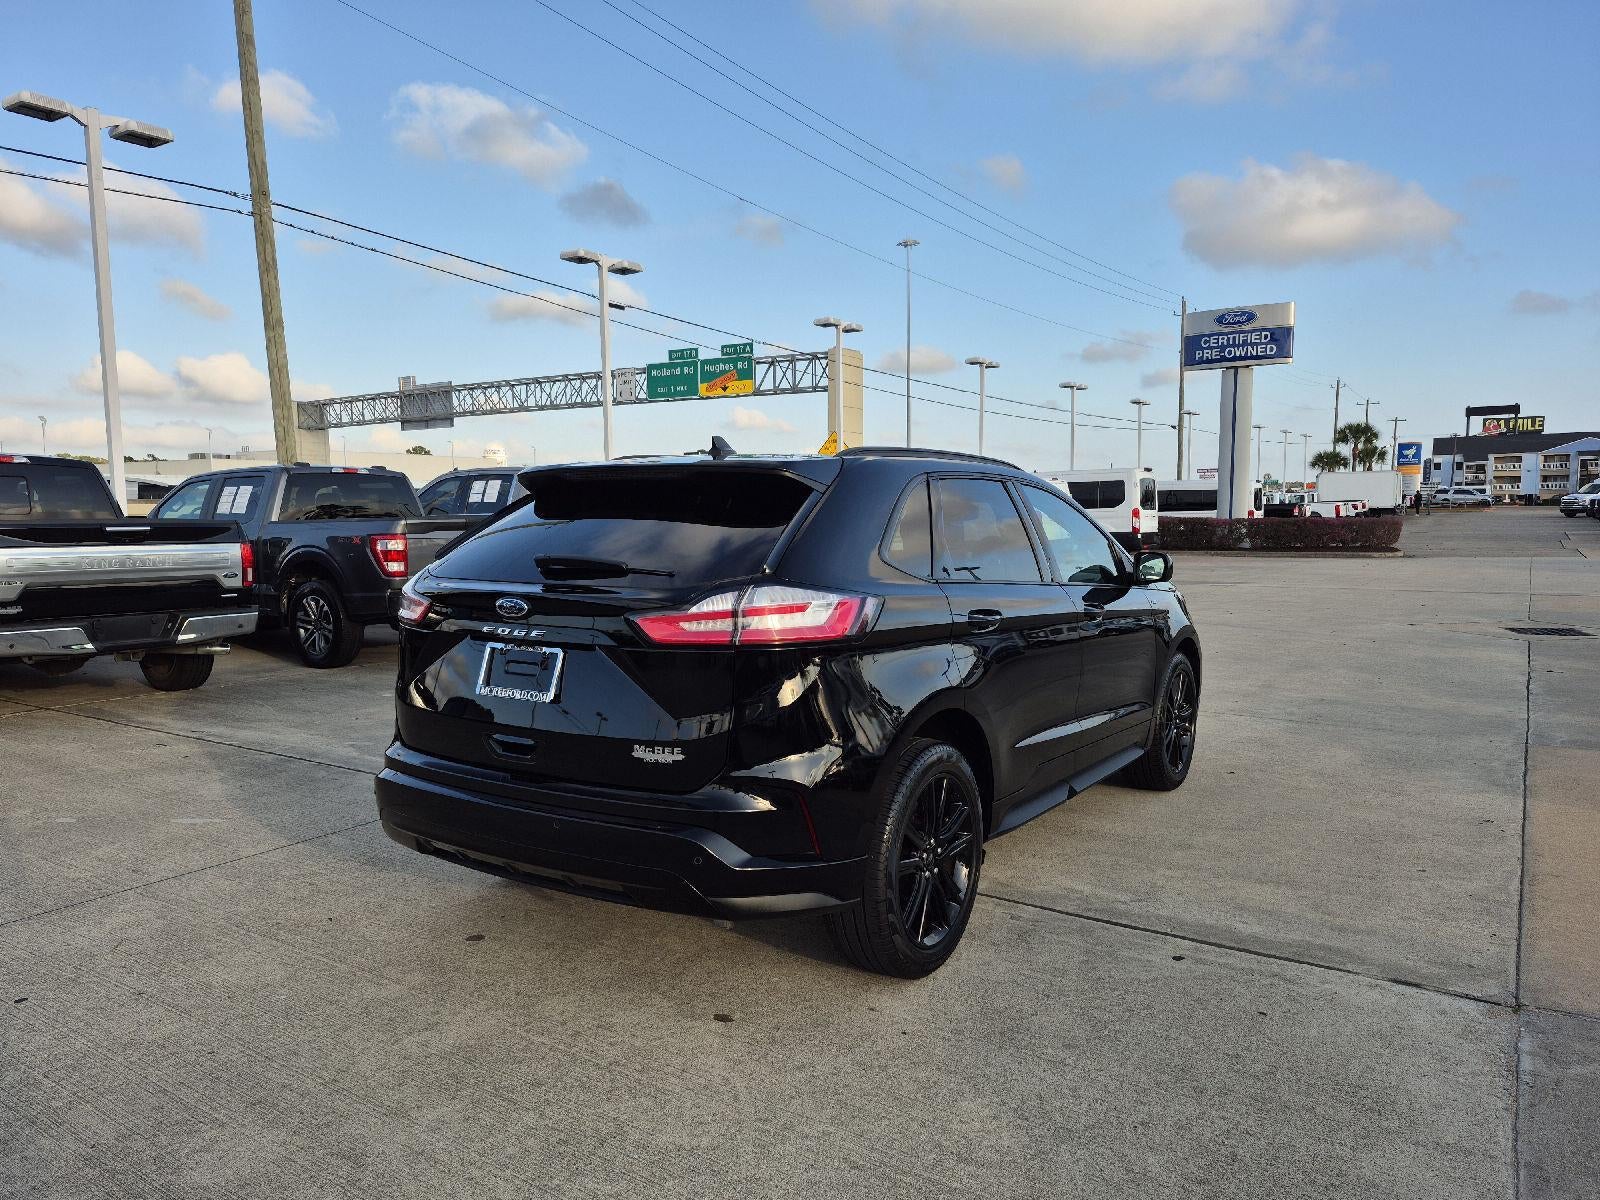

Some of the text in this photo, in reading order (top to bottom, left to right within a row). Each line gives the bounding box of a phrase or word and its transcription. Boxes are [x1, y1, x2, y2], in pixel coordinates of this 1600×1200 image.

[1222, 312, 1249, 324] Ford
[1201, 331, 1271, 347] CERTIFIED
[1195, 344, 1277, 360] PRE-OWNED
[651, 366, 694, 377] Holland Rd
[704, 360, 748, 373] Hughes Rd
[81, 556, 174, 569] KING RANCH
[482, 626, 547, 637] EDGE
